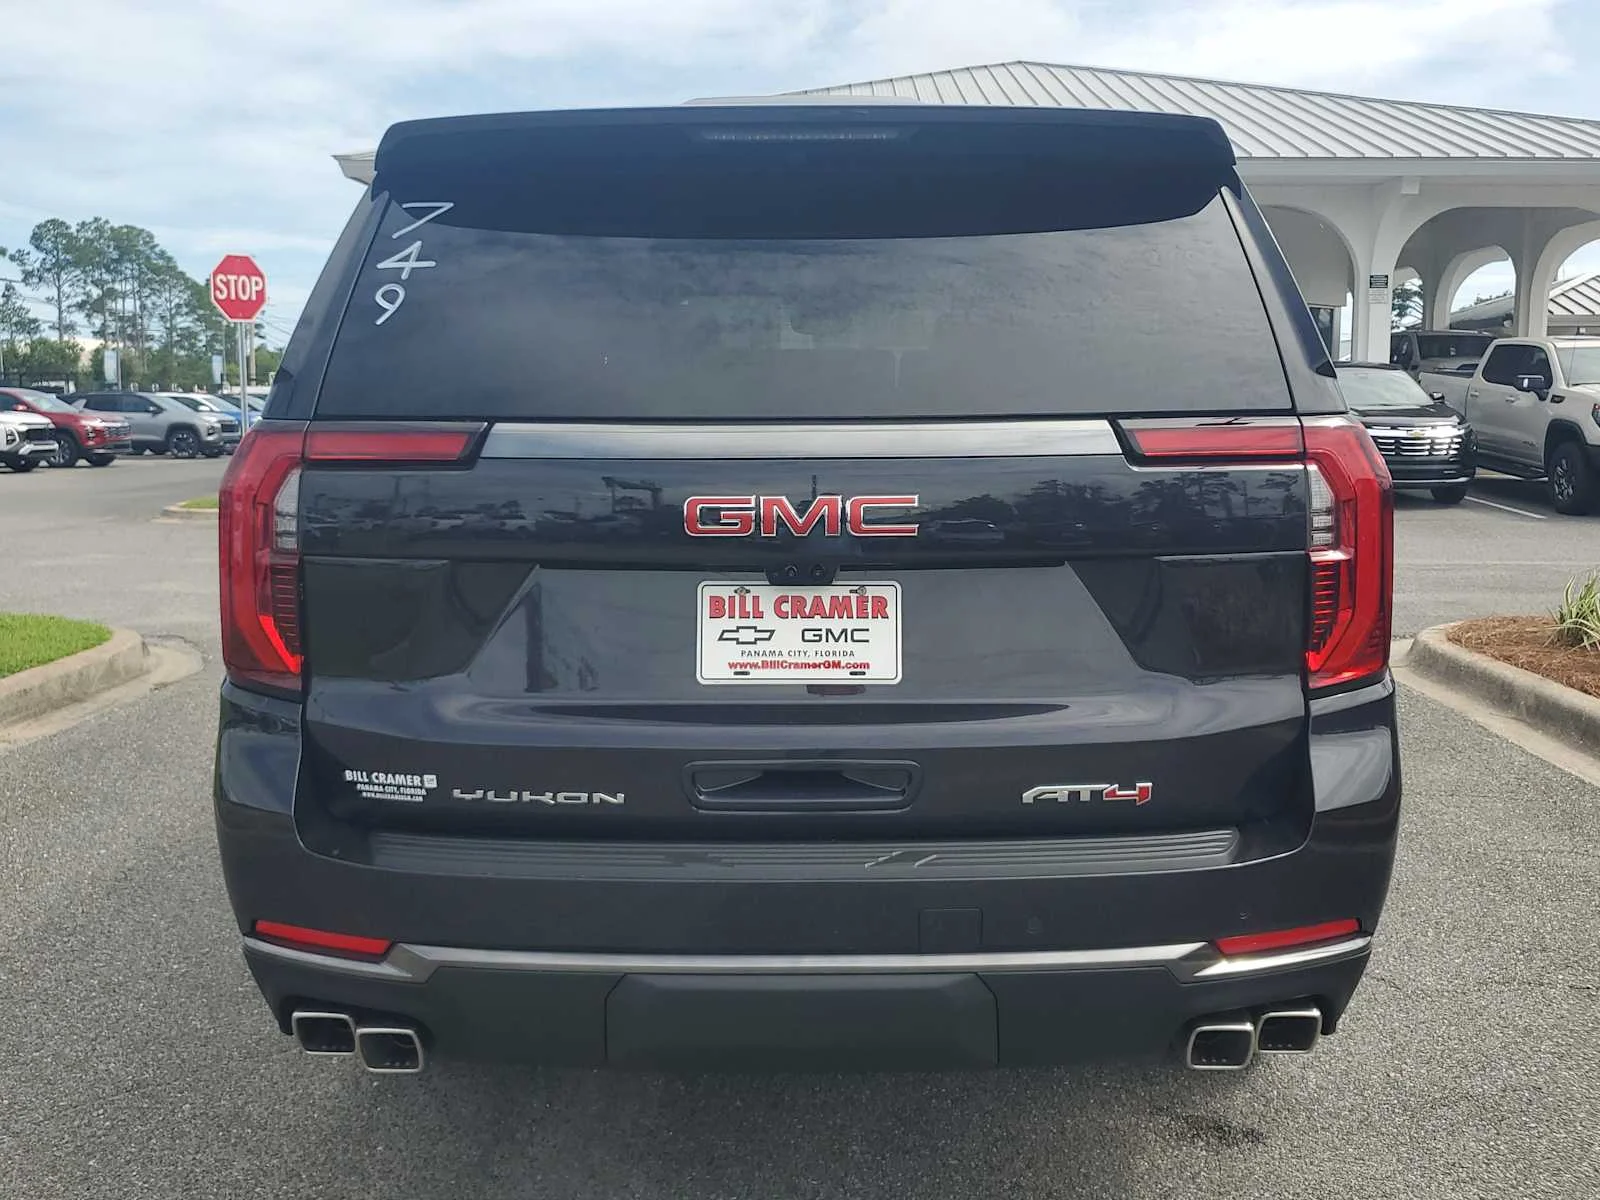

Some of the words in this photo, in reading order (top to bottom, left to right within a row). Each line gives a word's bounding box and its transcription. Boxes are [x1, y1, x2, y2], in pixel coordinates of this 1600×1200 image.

[215, 273, 264, 301] STOP
[684, 494, 919, 537] GMC
[709, 595, 764, 619] BILL
[774, 595, 889, 619] CRAMER
[801, 628, 870, 643] GMC
[787, 650, 811, 658] CITY,
[728, 660, 870, 669] www.BillCramerGM.com
[345, 770, 369, 782] BILL
[371, 772, 422, 786] CRAMER
[453, 789, 624, 804] YUKON
[1022, 783, 1152, 806] AT4
